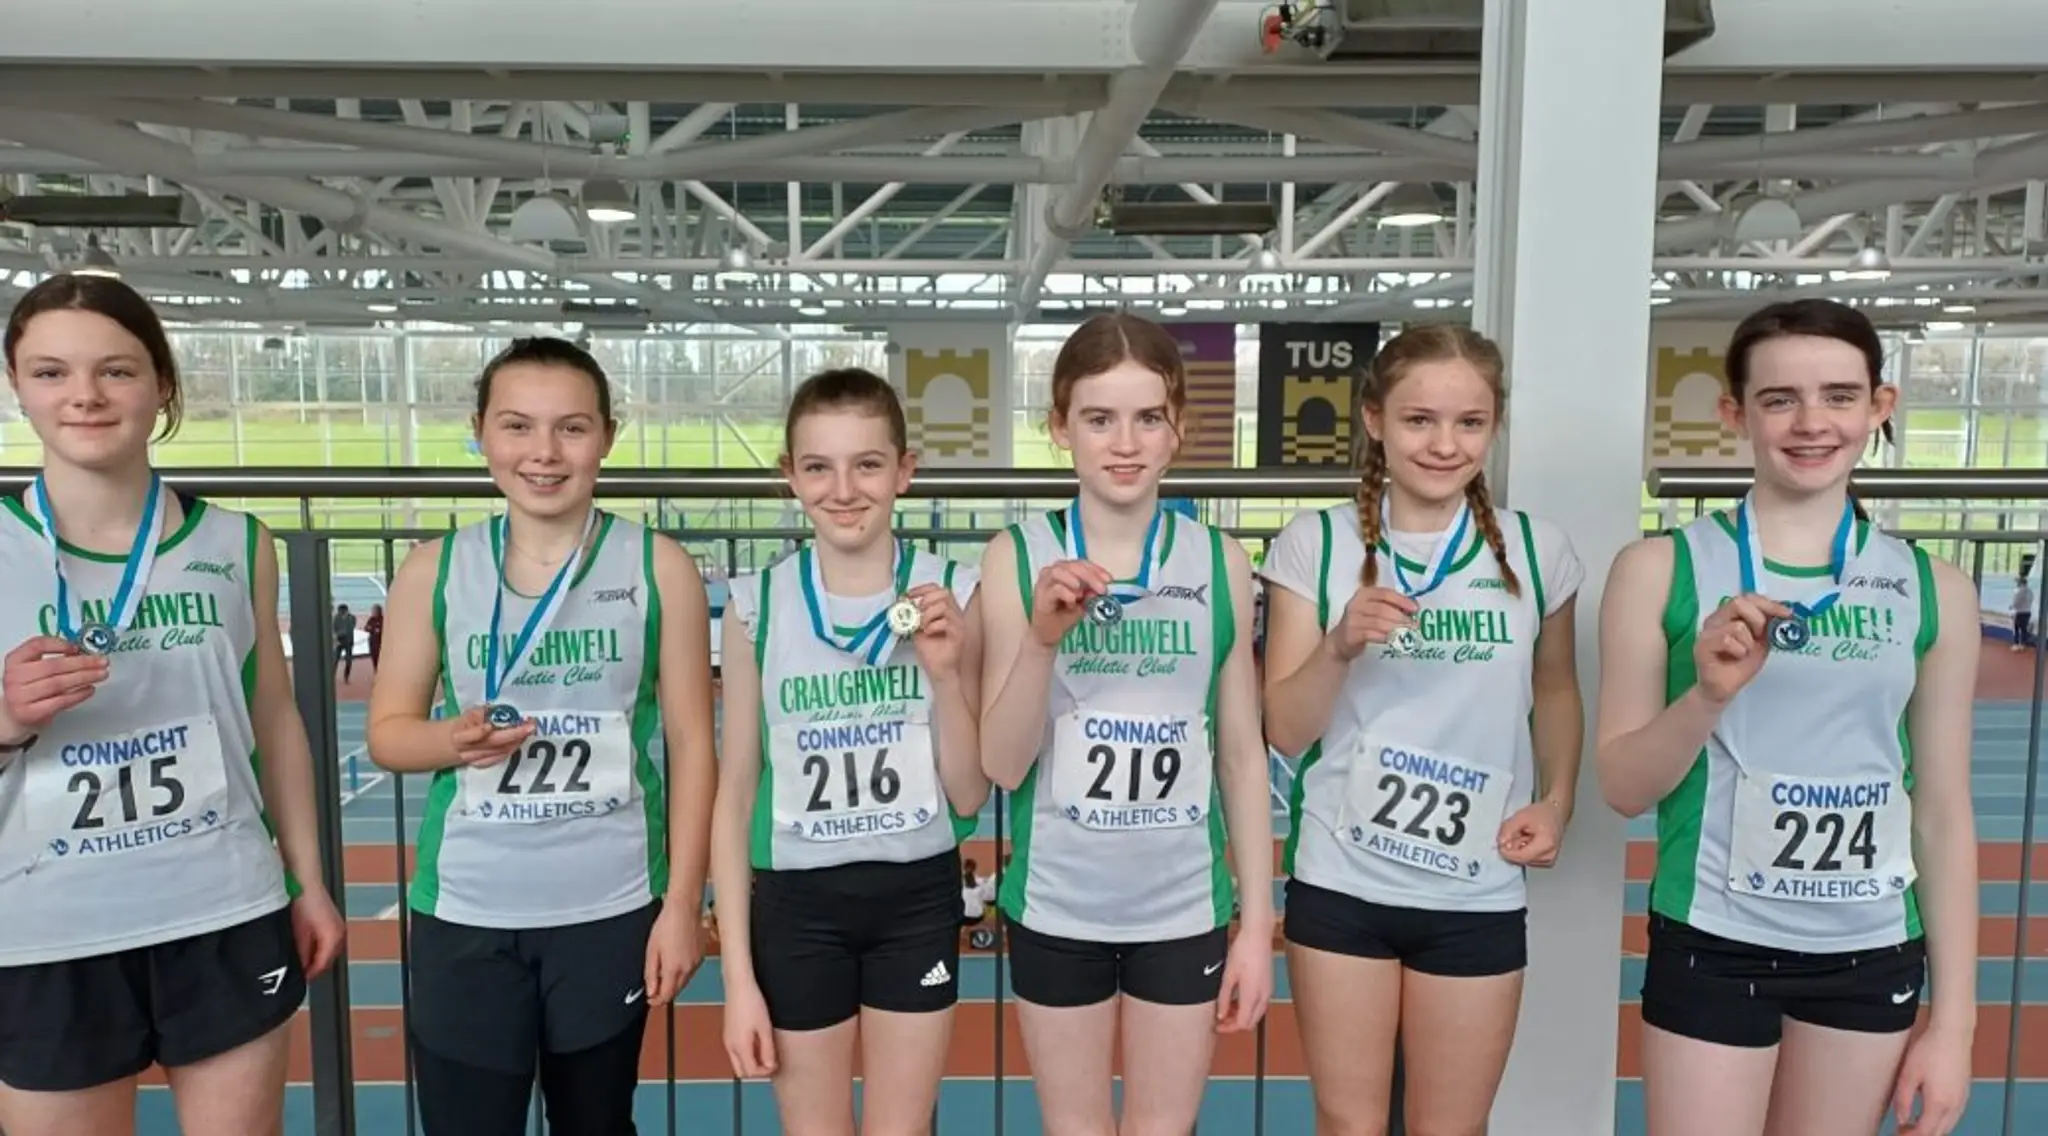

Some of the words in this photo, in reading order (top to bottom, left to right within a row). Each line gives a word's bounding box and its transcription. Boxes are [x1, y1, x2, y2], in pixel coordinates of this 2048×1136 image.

[1285, 340, 1353, 368] TUS
[160, 627, 205, 651] Club
[1060, 619, 1197, 655] RAUGHWELL
[1418, 608, 1514, 645] GHWELL
[1065, 656, 1130, 676] Athletic
[1136, 655, 1178, 678] Club
[1454, 643, 1495, 664] Club
[563, 665, 603, 687] Club
[779, 665, 925, 713] CRAUGHWELL
[535, 713, 602, 737] NACHT
[797, 721, 905, 751] CONNACHT
[1084, 717, 1188, 744] CONNACHT
[61, 725, 189, 767] CONNACHT
[497, 738, 591, 794] 222
[803, 748, 901, 812] 216
[1085, 743, 1181, 801] 219
[1379, 746, 1490, 794] CONNACHT
[67, 756, 185, 830] 215
[1771, 781, 1892, 809] CONNACHT
[498, 800, 595, 820] ATHLETICS
[810, 812, 906, 837] ATHLETICS
[1086, 806, 1178, 827] ATHLETICS
[1371, 773, 1471, 847] 223
[78, 819, 193, 855] ATHLETICS
[1367, 833, 1460, 872] ATHLETICS
[1772, 810, 1878, 872] 224
[1772, 877, 1880, 899] ATHLETICS
